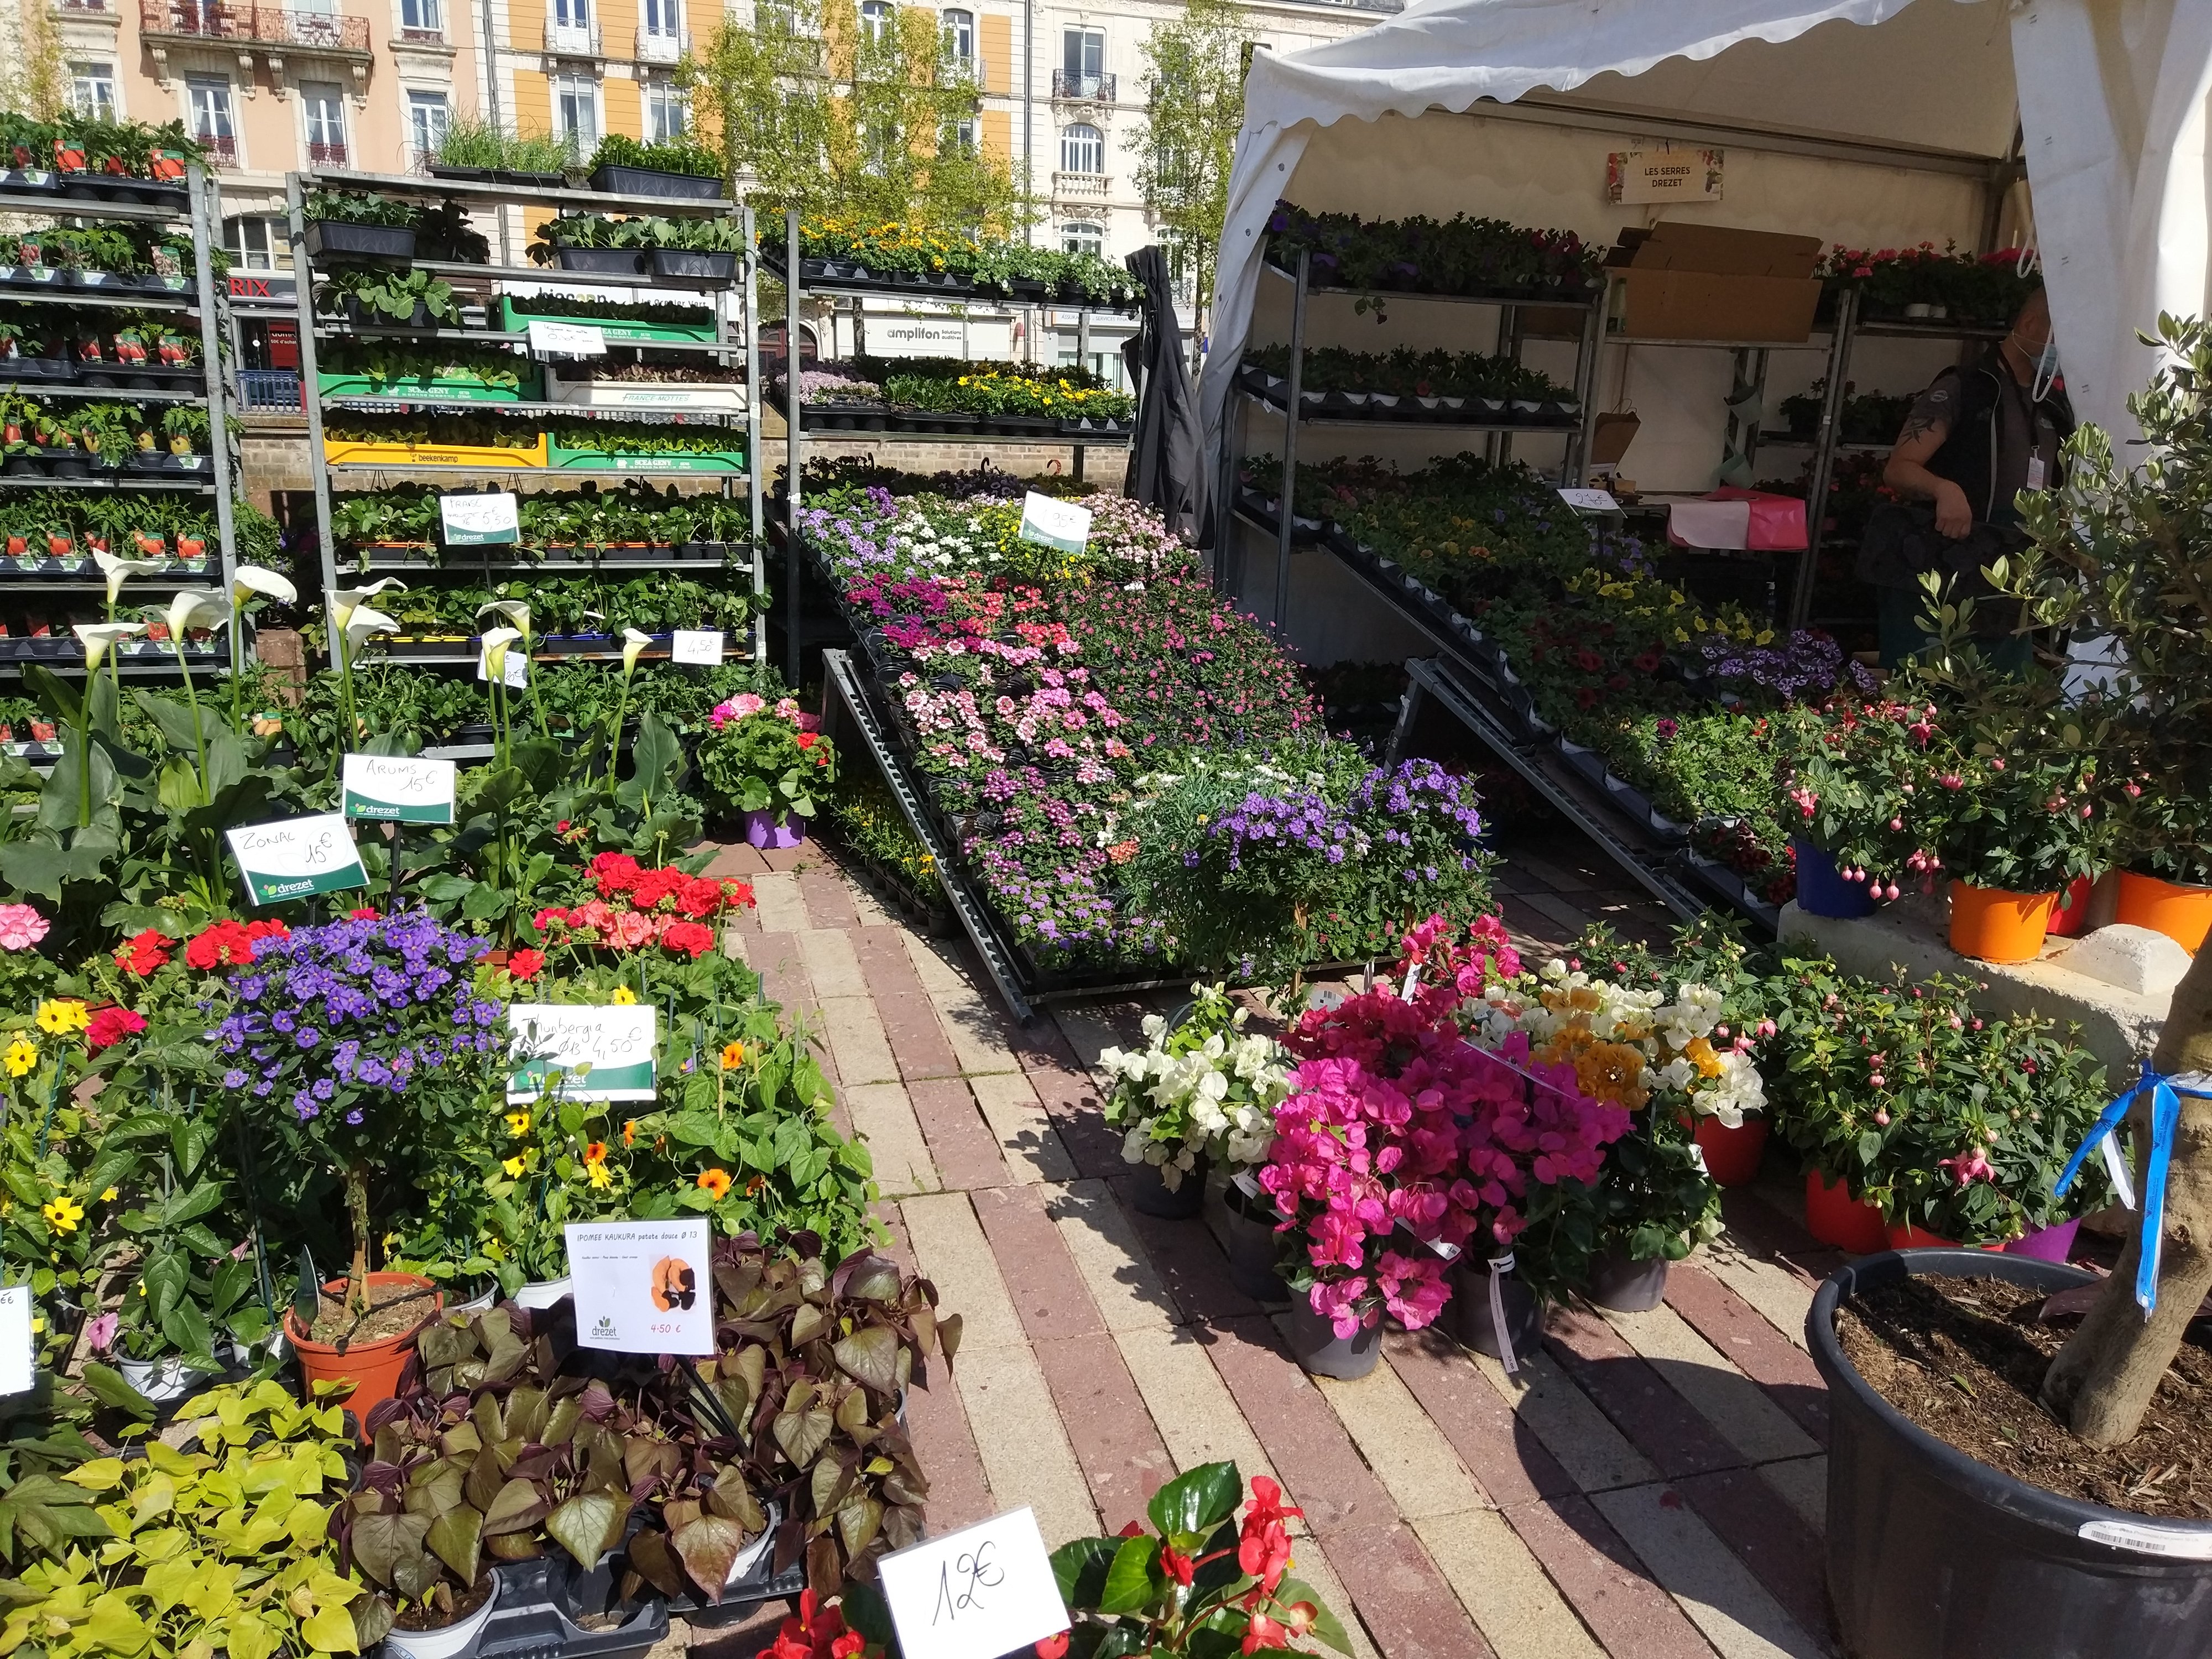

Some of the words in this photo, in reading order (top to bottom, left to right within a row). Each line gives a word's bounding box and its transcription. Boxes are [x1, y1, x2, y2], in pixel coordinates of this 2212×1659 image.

[1645, 168, 1658, 176] LES
[1661, 166, 1691, 175] SERRES
[1652, 179, 1683, 187] DREZET
[887, 327, 940, 342] amplifon
[419, 454, 458, 463] beekenkamp
[1034, 532, 1054, 542] drezet
[366, 759, 416, 775] ARUMS
[366, 805, 400, 815] drezet
[239, 832, 296, 850] ZONAL
[277, 878, 314, 894] drezet
[577, 1234, 602, 1242] IPOMEE
[604, 1233, 635, 1241] KAUKURA
[638, 1233, 659, 1241] patate
[689, 1230, 697, 1239] 13
[592, 1325, 617, 1337] drezet
[675, 1324, 681, 1333] €
[932, 1541, 1005, 1626] 12€
